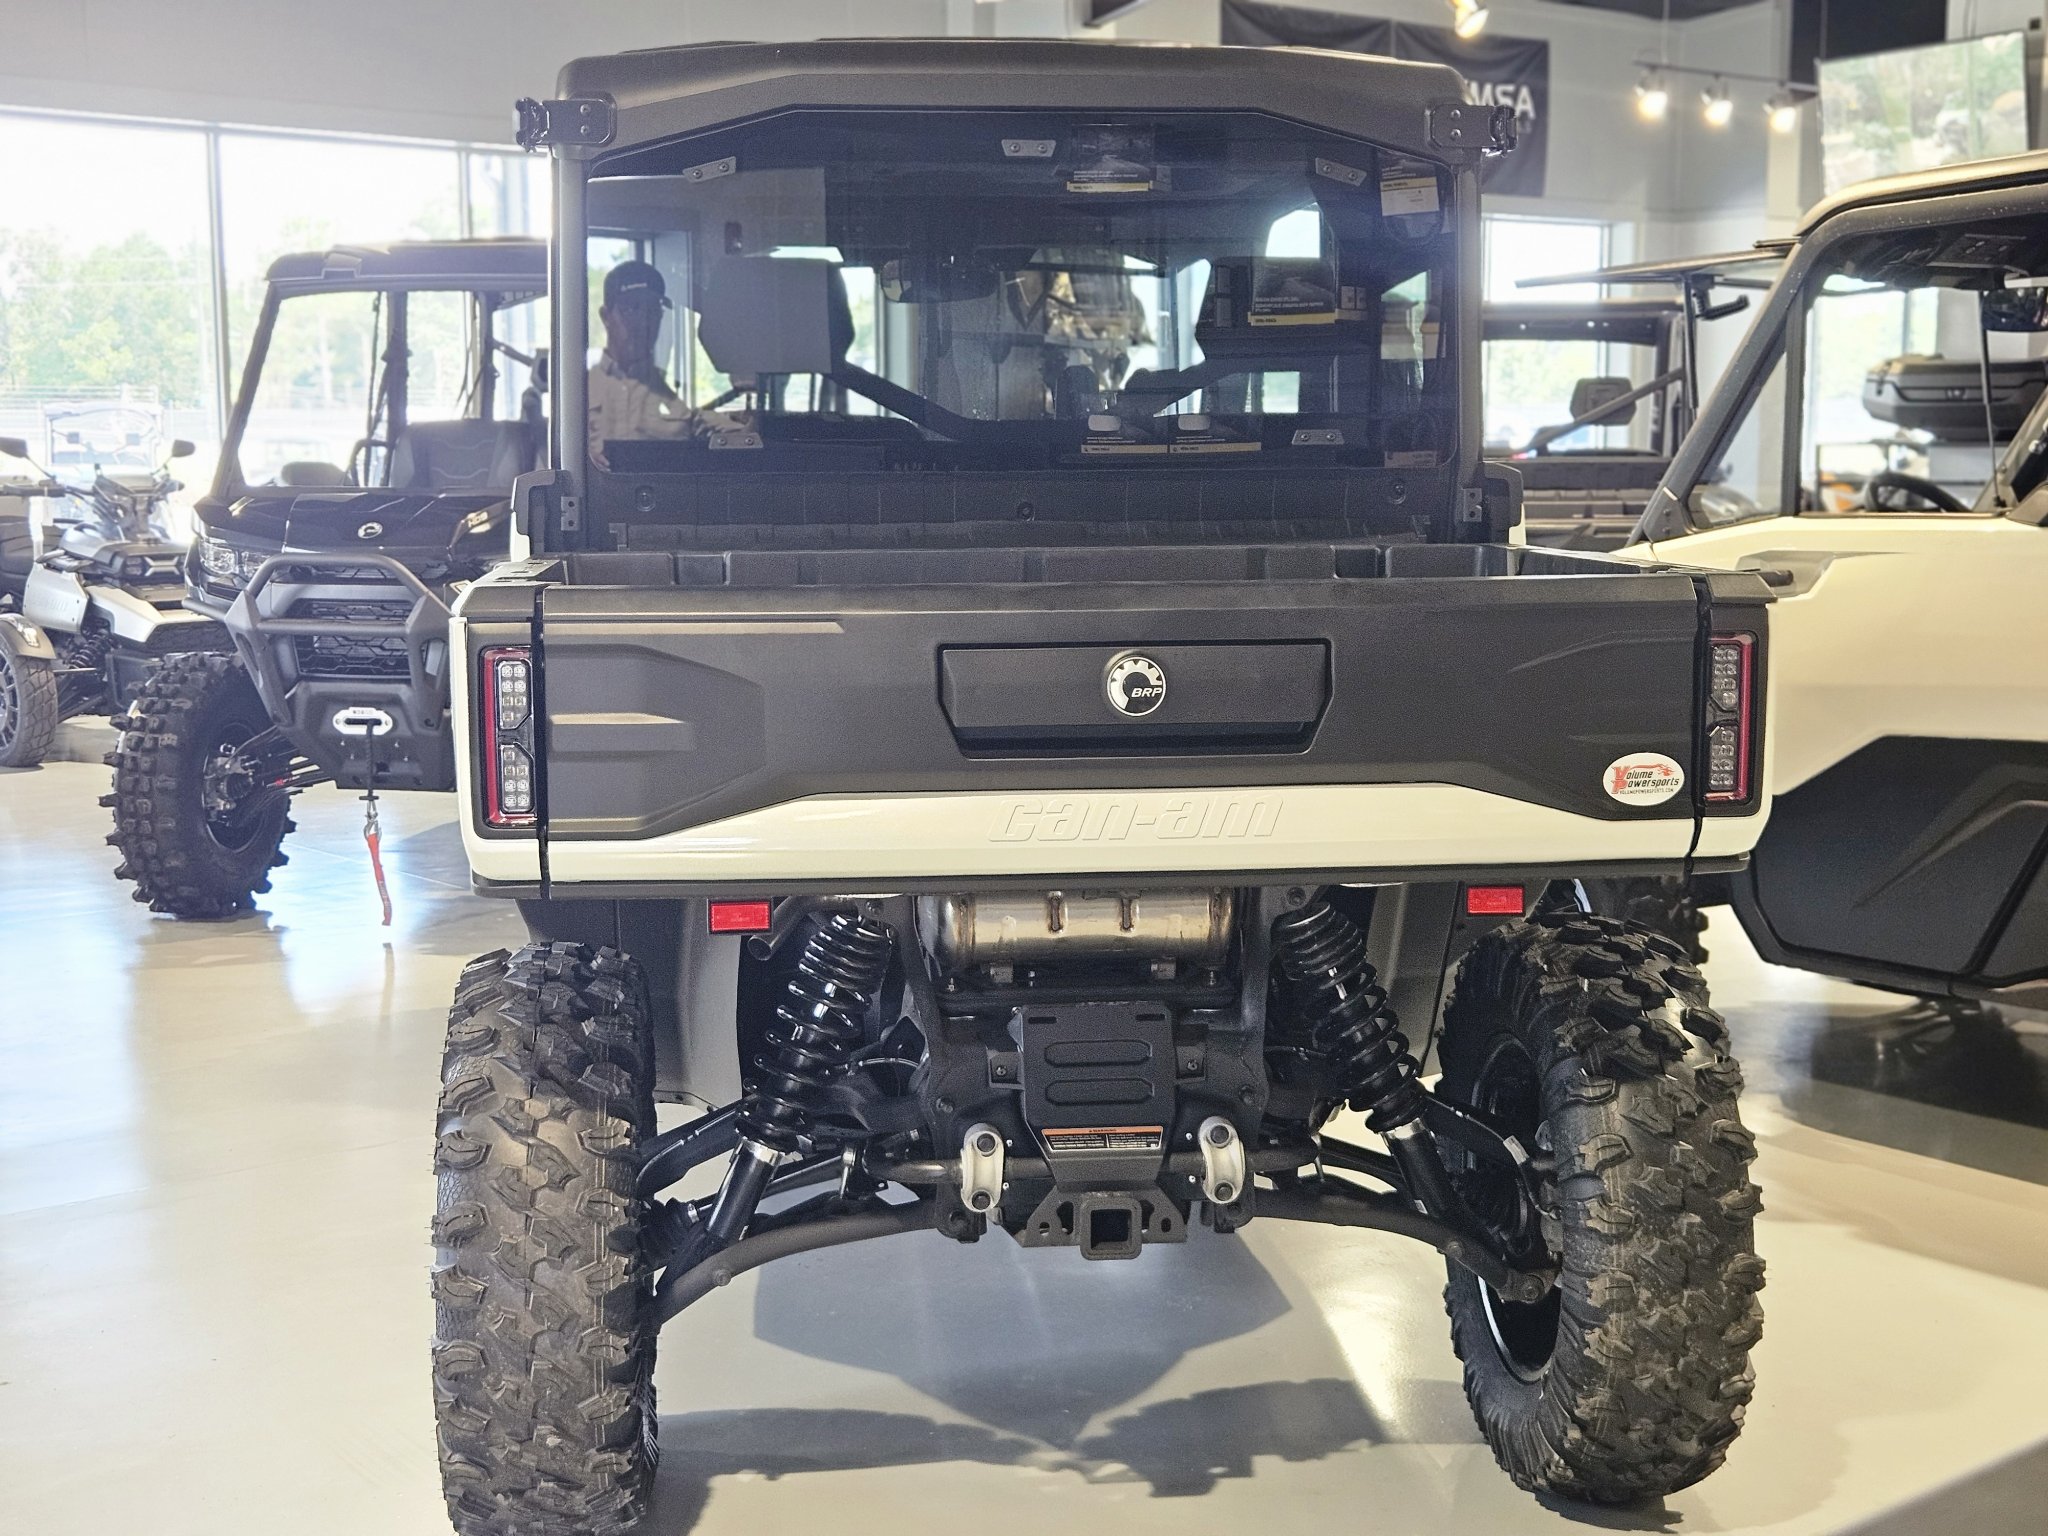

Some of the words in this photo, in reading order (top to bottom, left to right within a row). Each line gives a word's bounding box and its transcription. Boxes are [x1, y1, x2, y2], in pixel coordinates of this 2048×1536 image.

[1131, 687, 1163, 698] BRP
[1611, 766, 1654, 780] Volume
[1611, 777, 1680, 795] Powersports
[988, 795, 1283, 842] can-am
